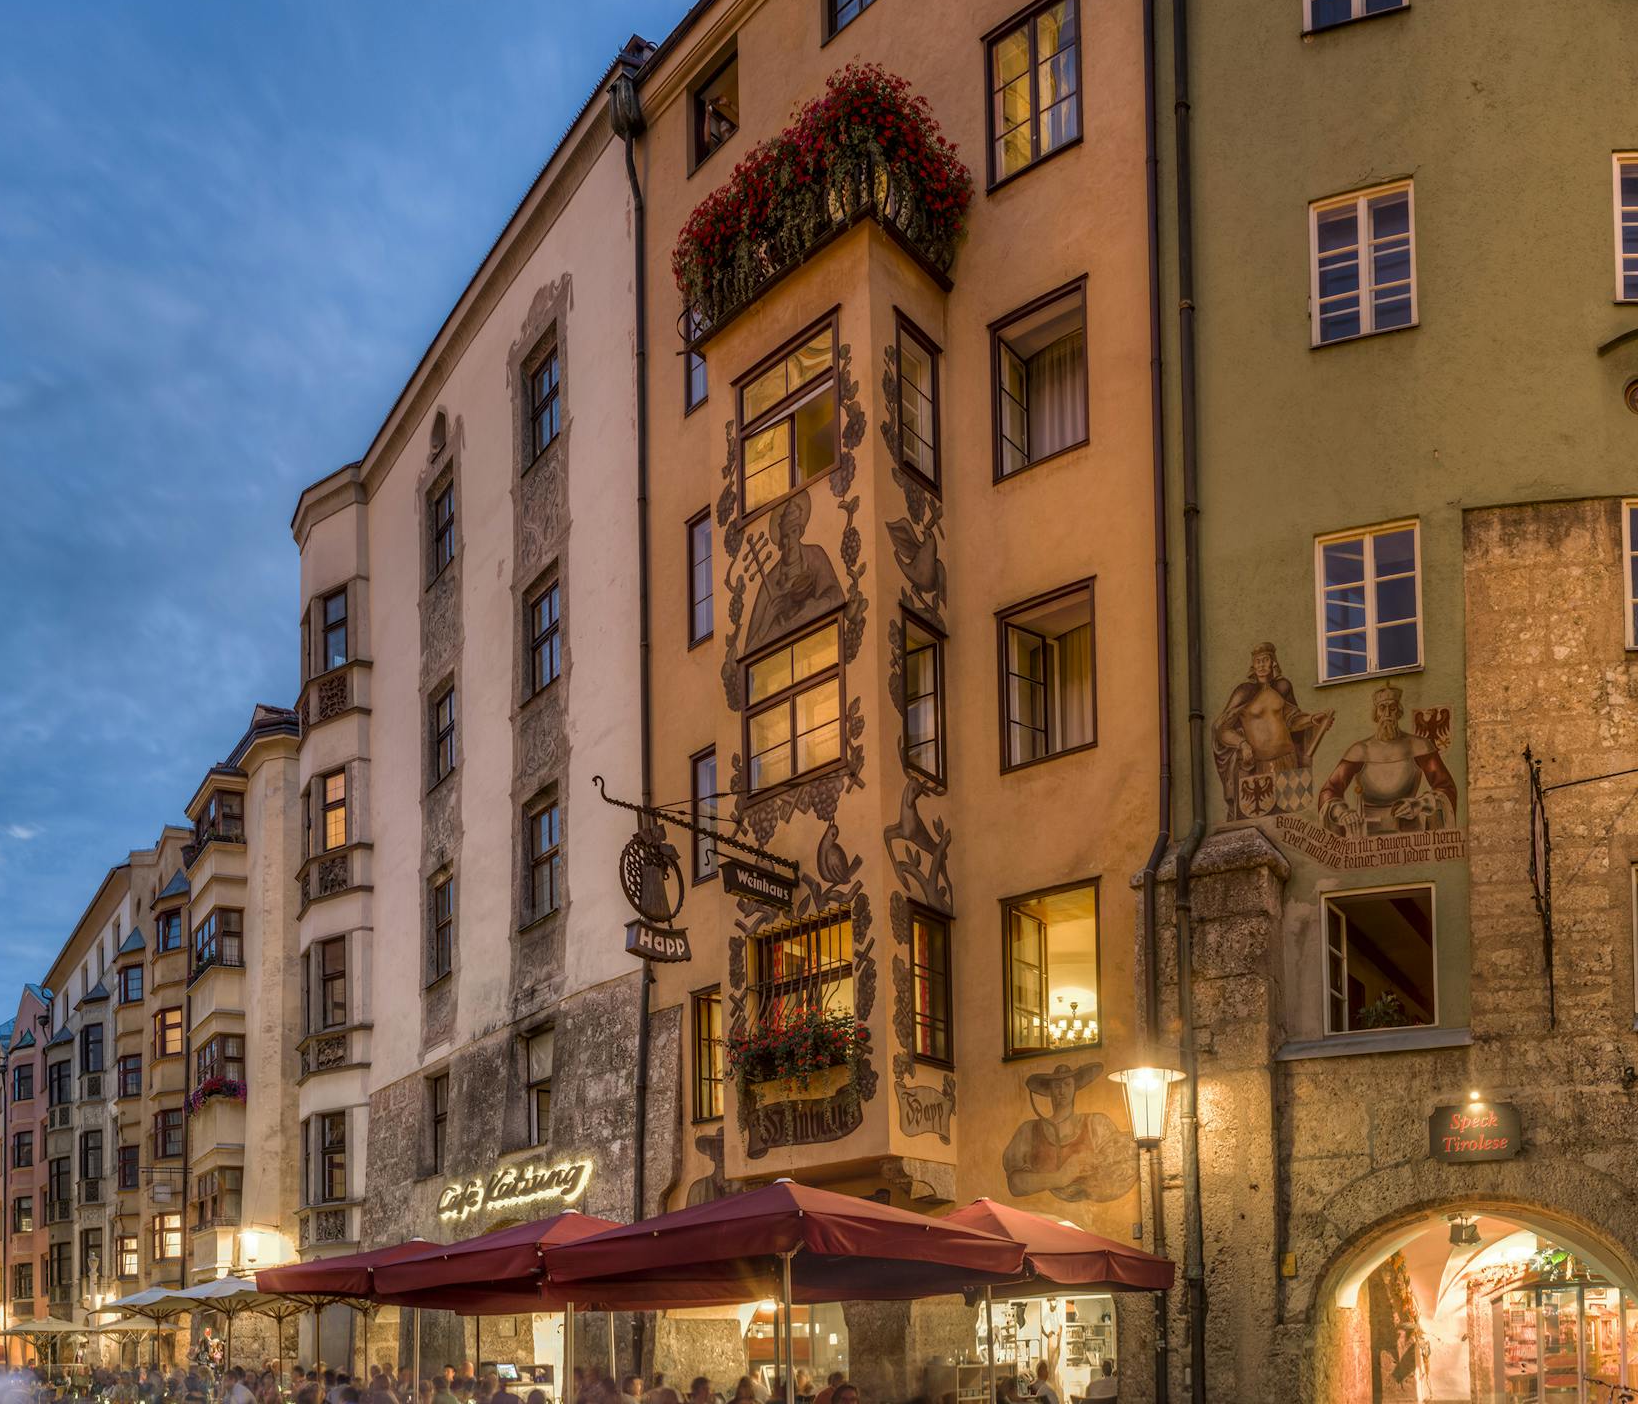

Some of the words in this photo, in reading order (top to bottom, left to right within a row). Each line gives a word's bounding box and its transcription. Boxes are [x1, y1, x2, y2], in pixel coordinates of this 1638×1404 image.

[1276, 815, 1306, 834] Beutel
[1307, 824, 1326, 844] und
[1376, 835, 1412, 853] Bauern
[1413, 831, 1431, 848] und
[1305, 841, 1328, 864] mag
[1379, 848, 1399, 866] voll
[736, 869, 790, 902] Weinhaus
[639, 927, 686, 957] Happ
[1449, 1109, 1499, 1133] Speck
[1441, 1133, 1510, 1153] Tirolese
[484, 1163, 587, 1202] Katzung
